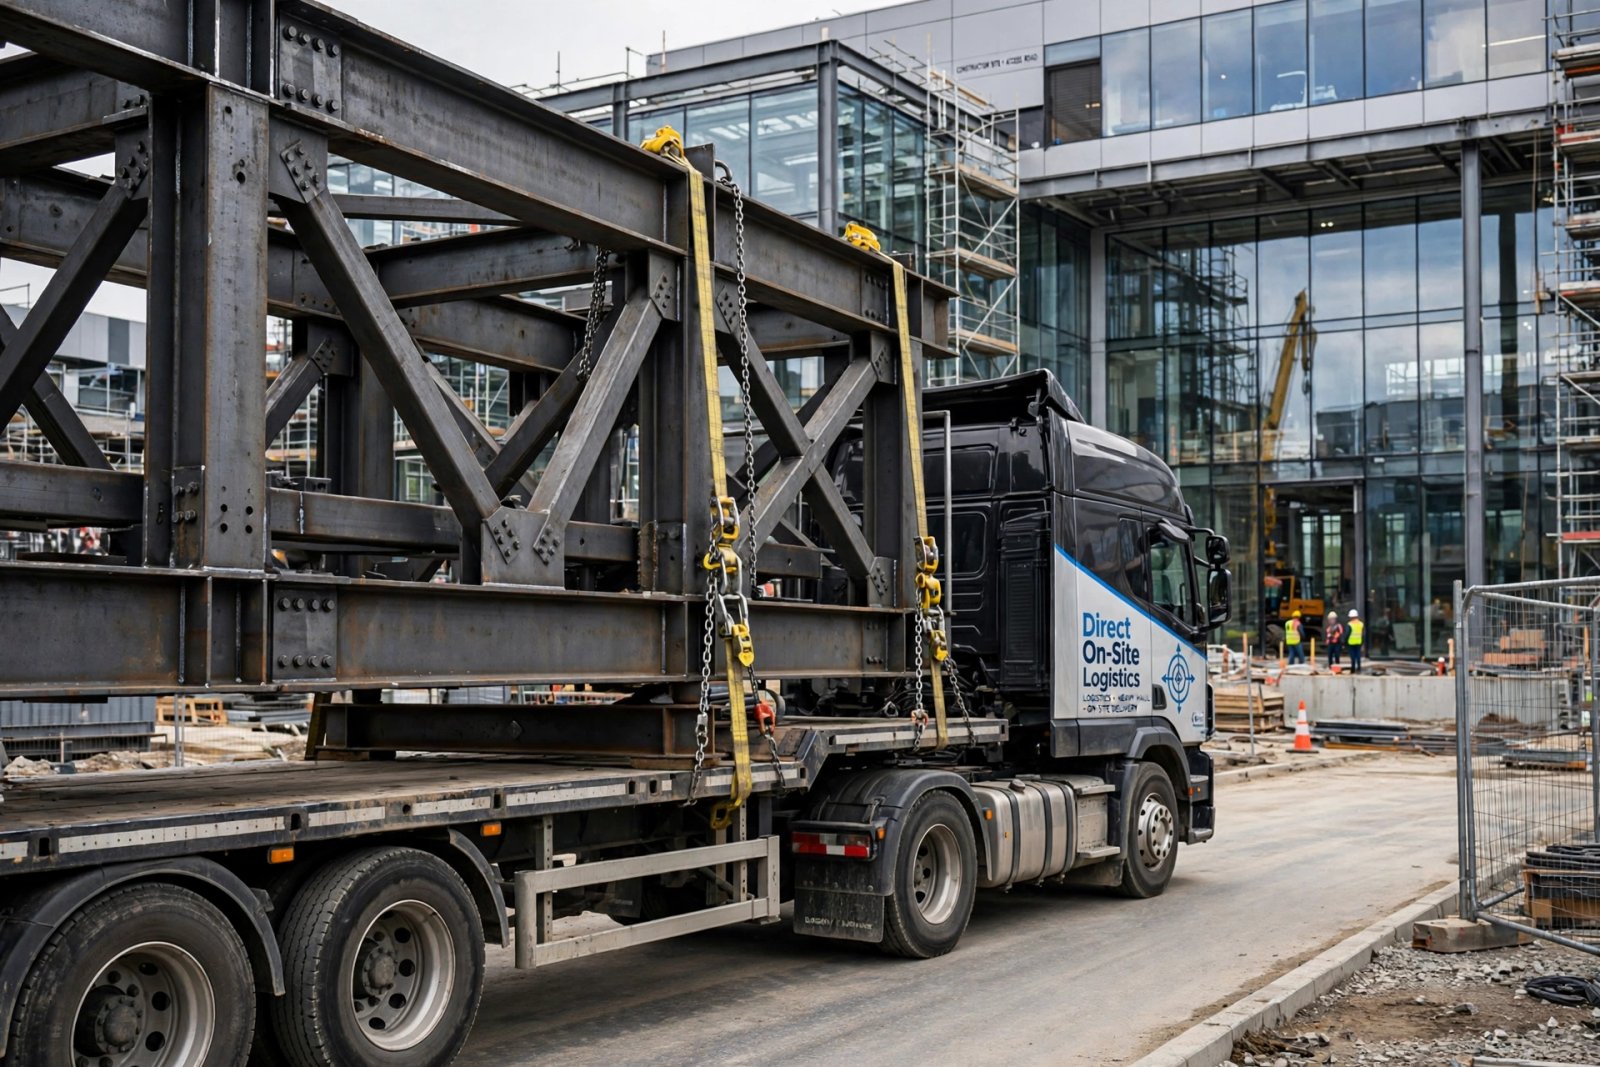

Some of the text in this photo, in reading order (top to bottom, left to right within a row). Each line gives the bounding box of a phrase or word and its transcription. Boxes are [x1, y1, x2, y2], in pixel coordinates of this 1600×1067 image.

[1083, 612, 1131, 639] Direct
[1083, 640, 1140, 665] On-Site
[1083, 666, 1140, 692] Logistics
